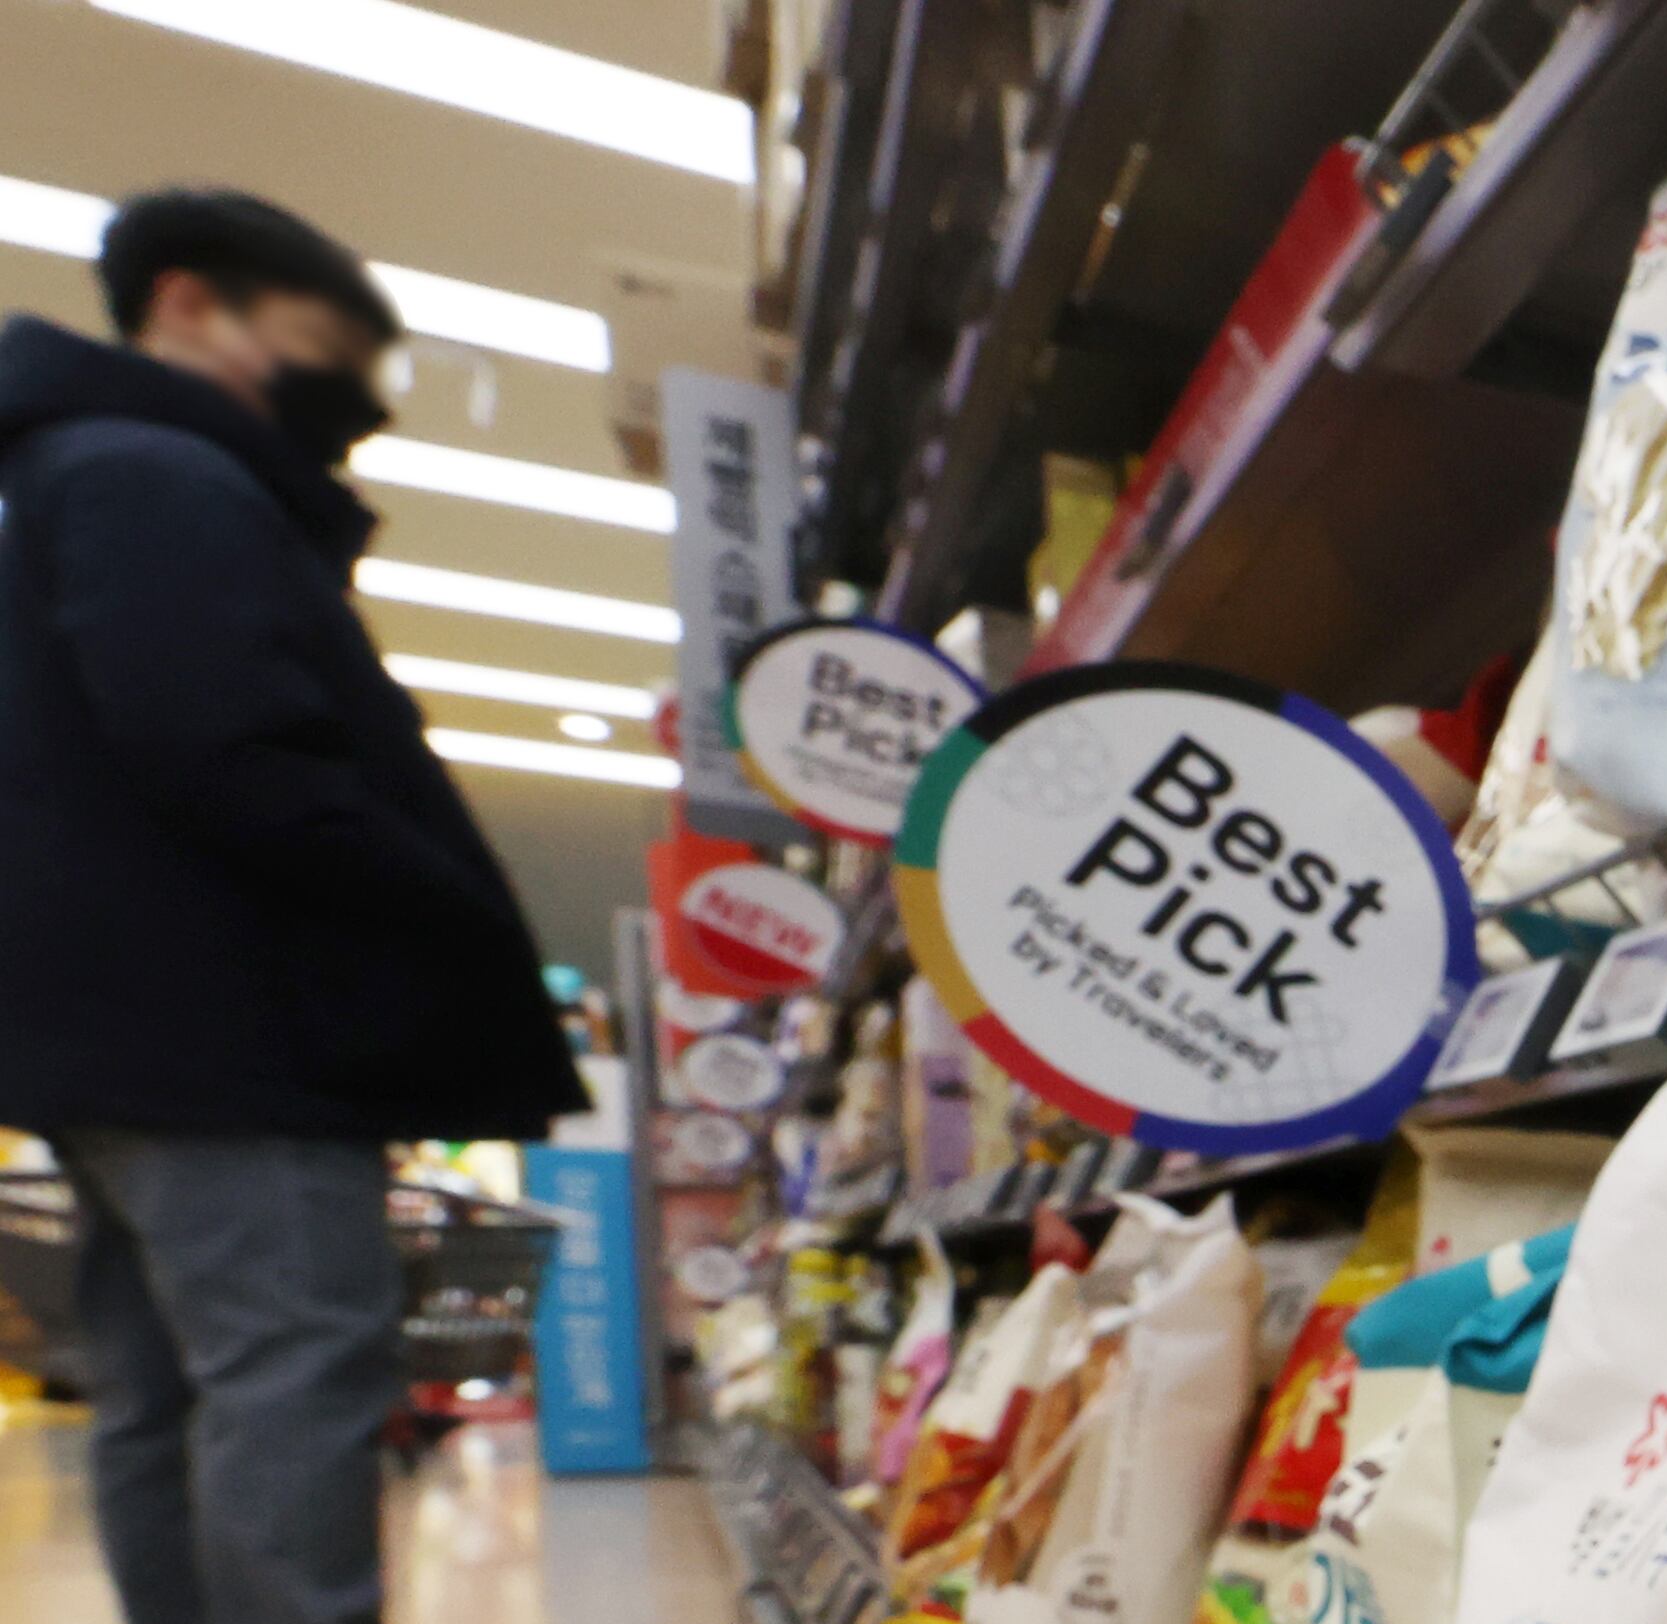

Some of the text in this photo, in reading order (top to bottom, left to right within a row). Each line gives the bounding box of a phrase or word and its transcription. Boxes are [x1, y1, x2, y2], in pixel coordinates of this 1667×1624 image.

[807, 650, 944, 728] Best
[1131, 733, 1386, 950] Best
[704, 885, 821, 955] NEW
[1007, 886, 1139, 980] Picked
[1170, 992, 1281, 1075] Loved
[1010, 931, 1060, 977] by
[1065, 817, 1323, 1027] Pick
